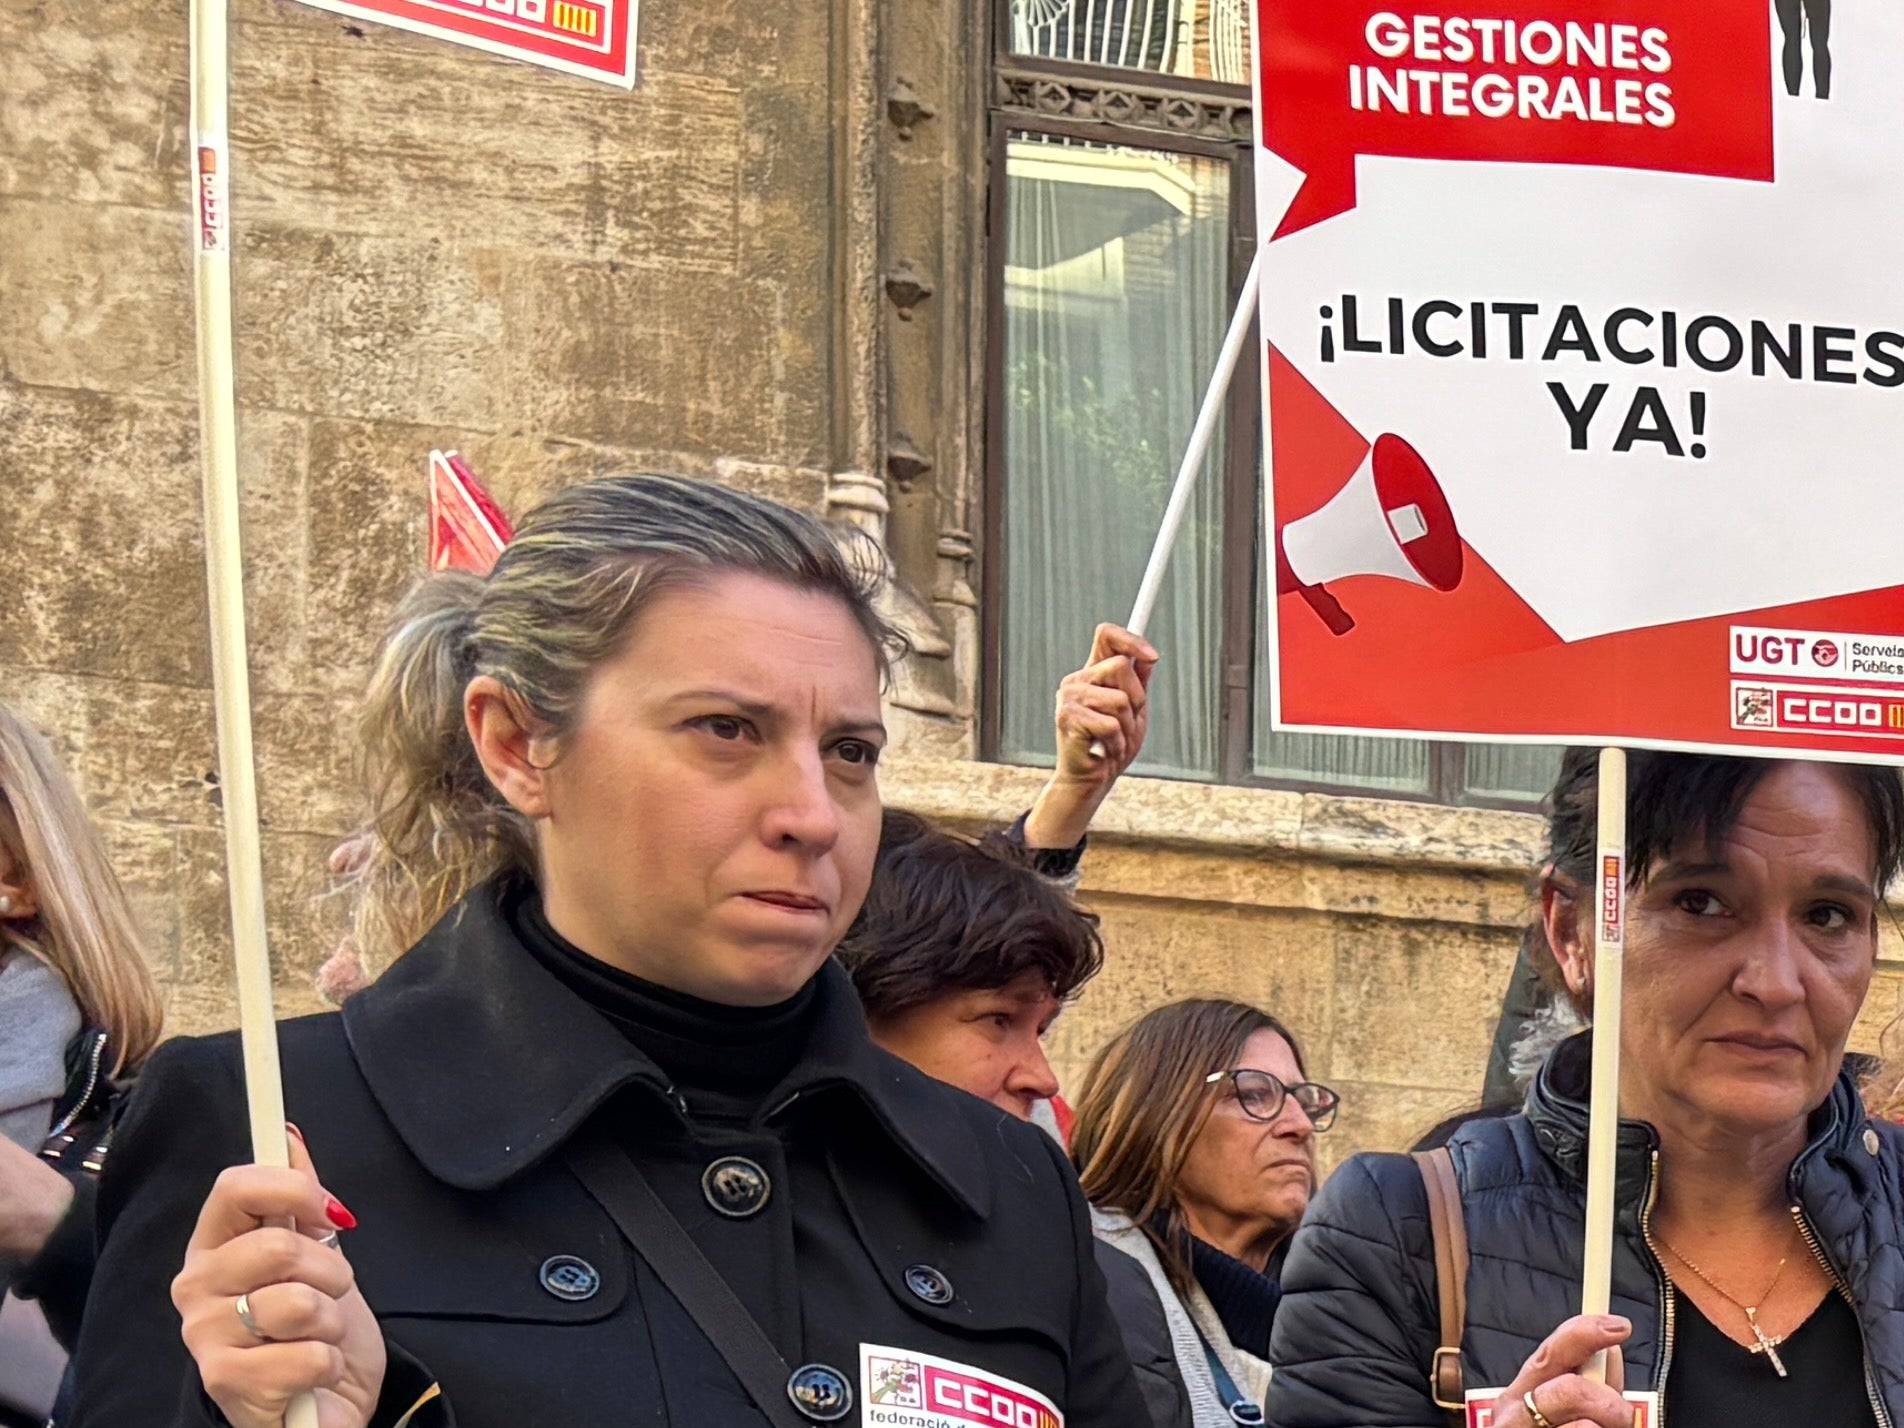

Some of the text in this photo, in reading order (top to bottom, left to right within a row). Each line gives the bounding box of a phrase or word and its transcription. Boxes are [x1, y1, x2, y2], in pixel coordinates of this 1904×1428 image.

[1364, 11, 1672, 73] GESTIONES
[1348, 65, 1677, 128] INTEGRALES
[1546, 382, 1707, 460] YA!
[1736, 634, 1806, 665] UGT
[1784, 698, 1882, 725] CCOO
